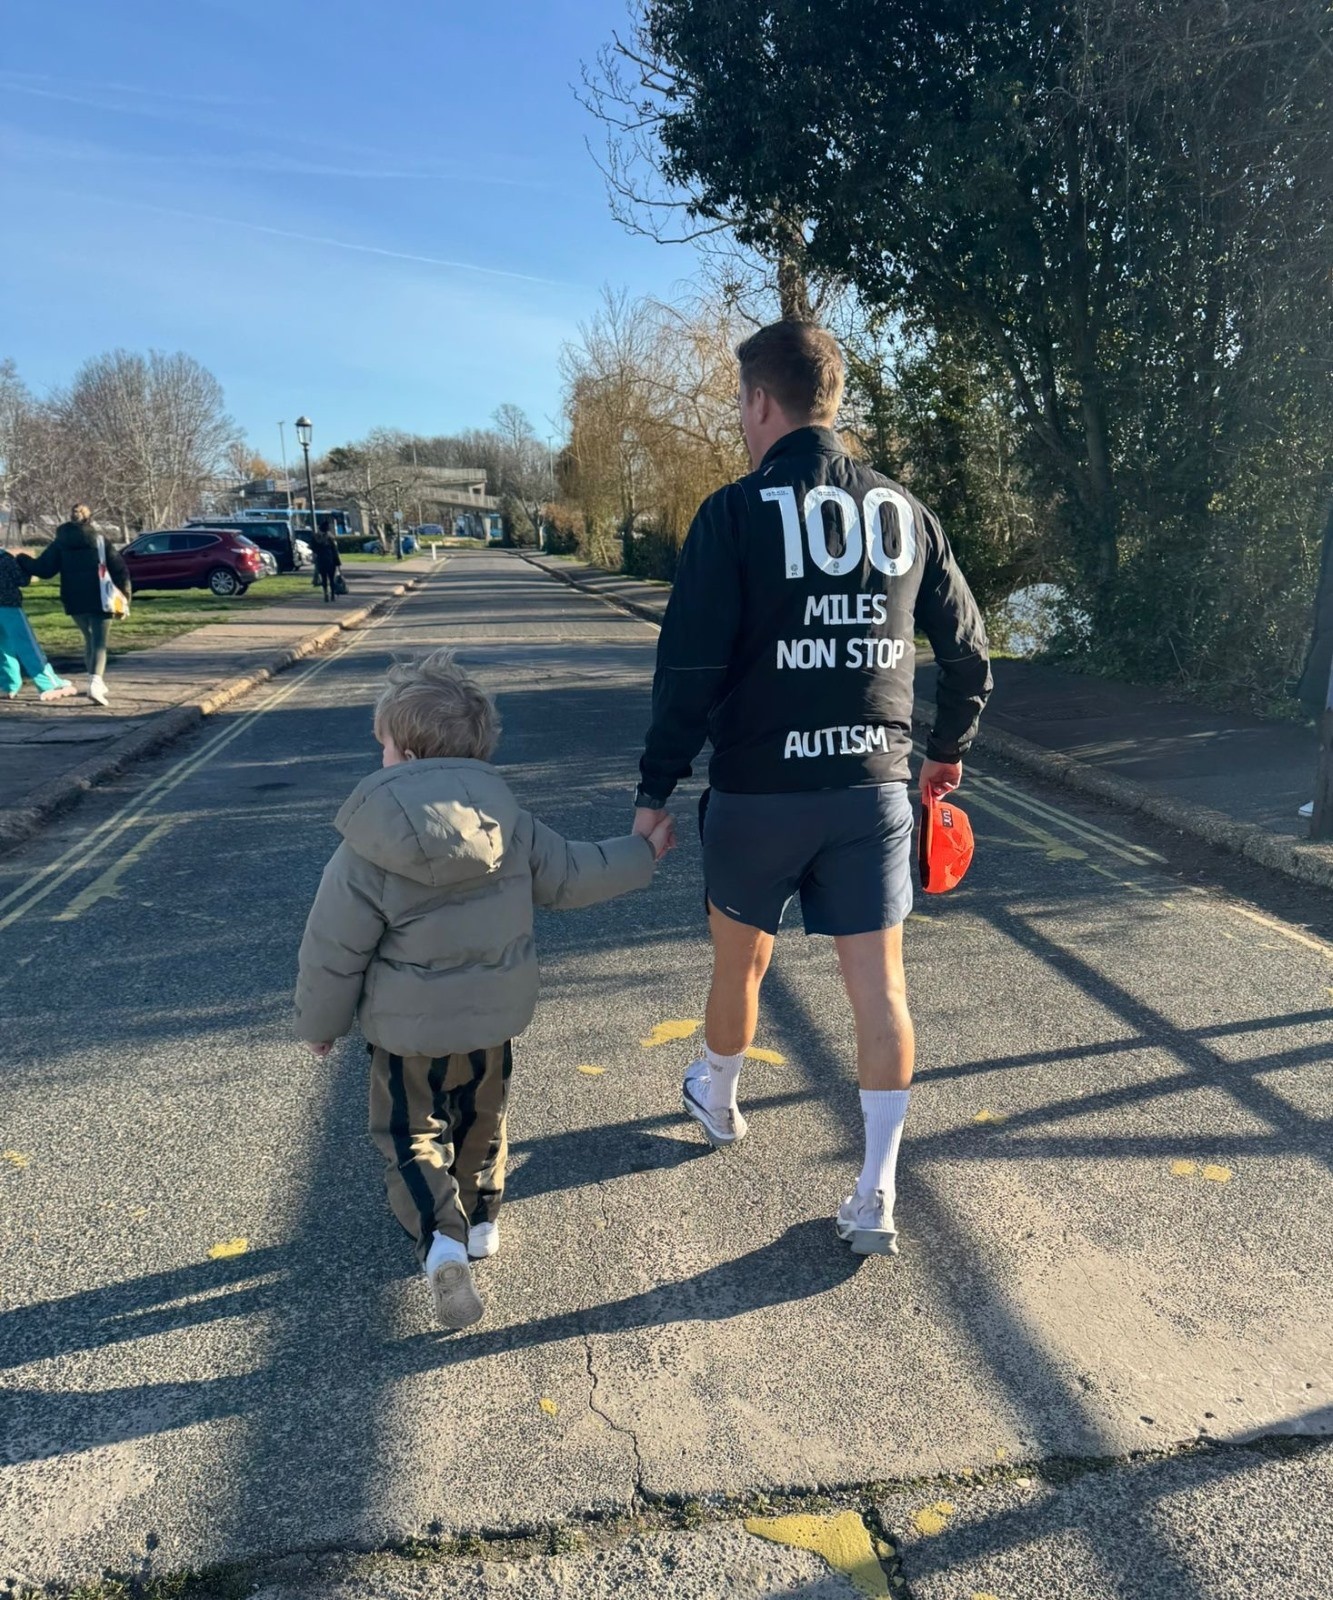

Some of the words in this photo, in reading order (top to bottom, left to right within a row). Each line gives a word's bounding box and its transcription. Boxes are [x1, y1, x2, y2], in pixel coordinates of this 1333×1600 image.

[759, 485, 916, 579] 100
[804, 593, 888, 626] MILES
[776, 638, 836, 670] NON
[845, 638, 905, 670] STOP
[784, 724, 890, 759] AUTISM
